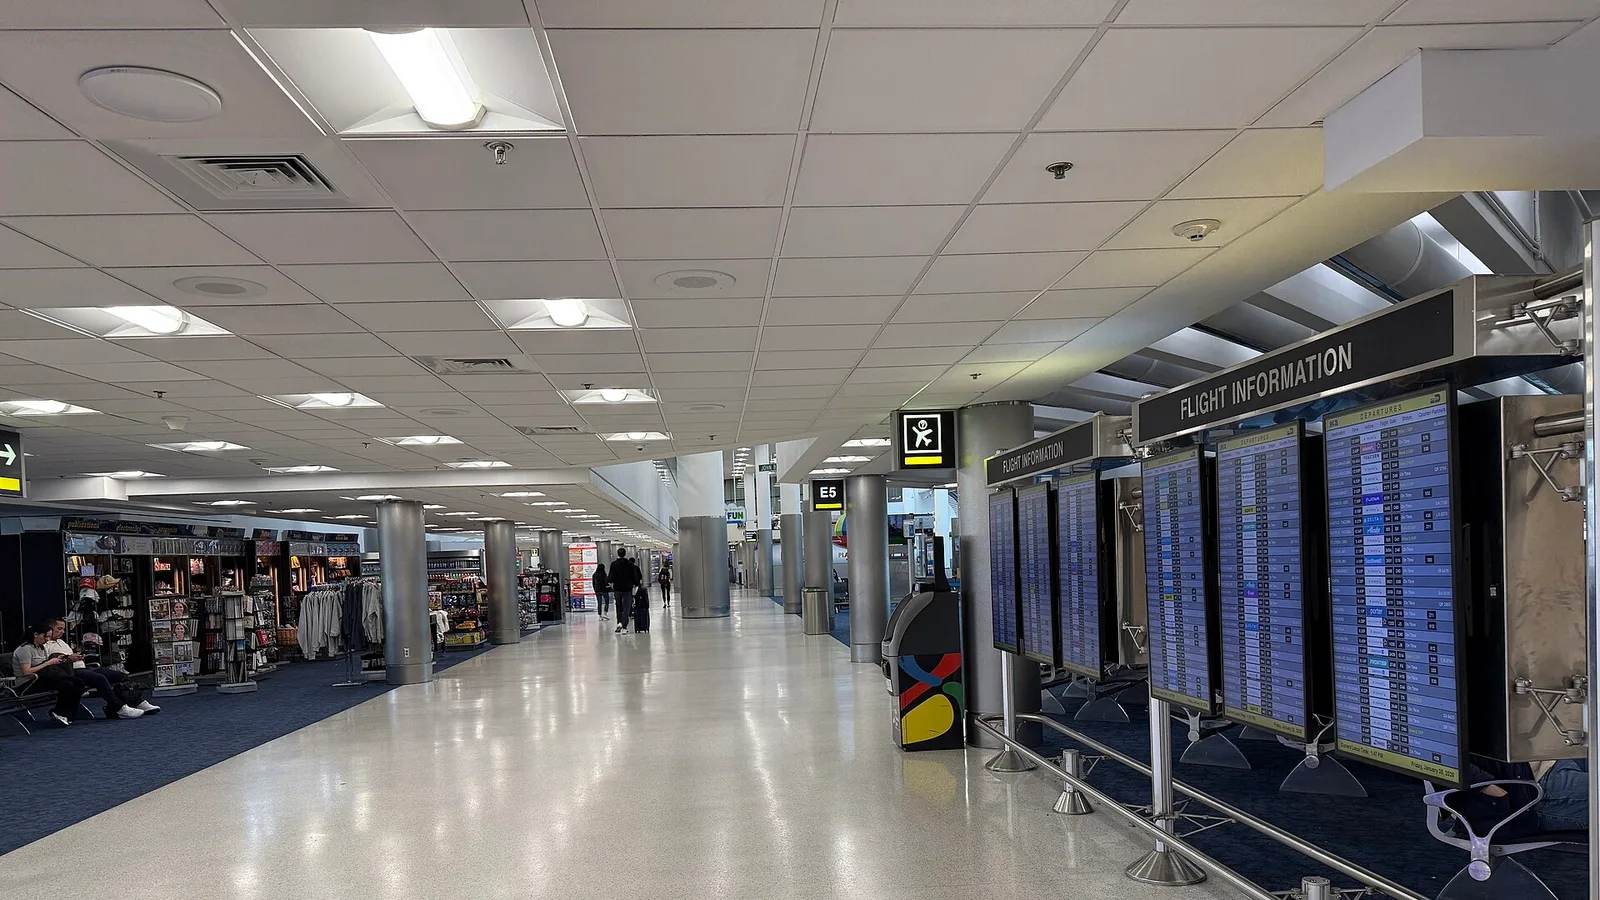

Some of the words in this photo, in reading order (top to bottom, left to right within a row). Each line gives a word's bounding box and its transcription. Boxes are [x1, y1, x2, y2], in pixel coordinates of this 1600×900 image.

[1180, 386, 1228, 420] FLIGHT
[1232, 342, 1353, 405] INFORMATION
[1360, 404, 1402, 420] DEPARTURES
[1002, 453, 1021, 474] FLIGHT
[1022, 441, 1064, 469] INFORMATION
[820, 486, 837, 499] E5
[727, 512, 743, 520] FUN
